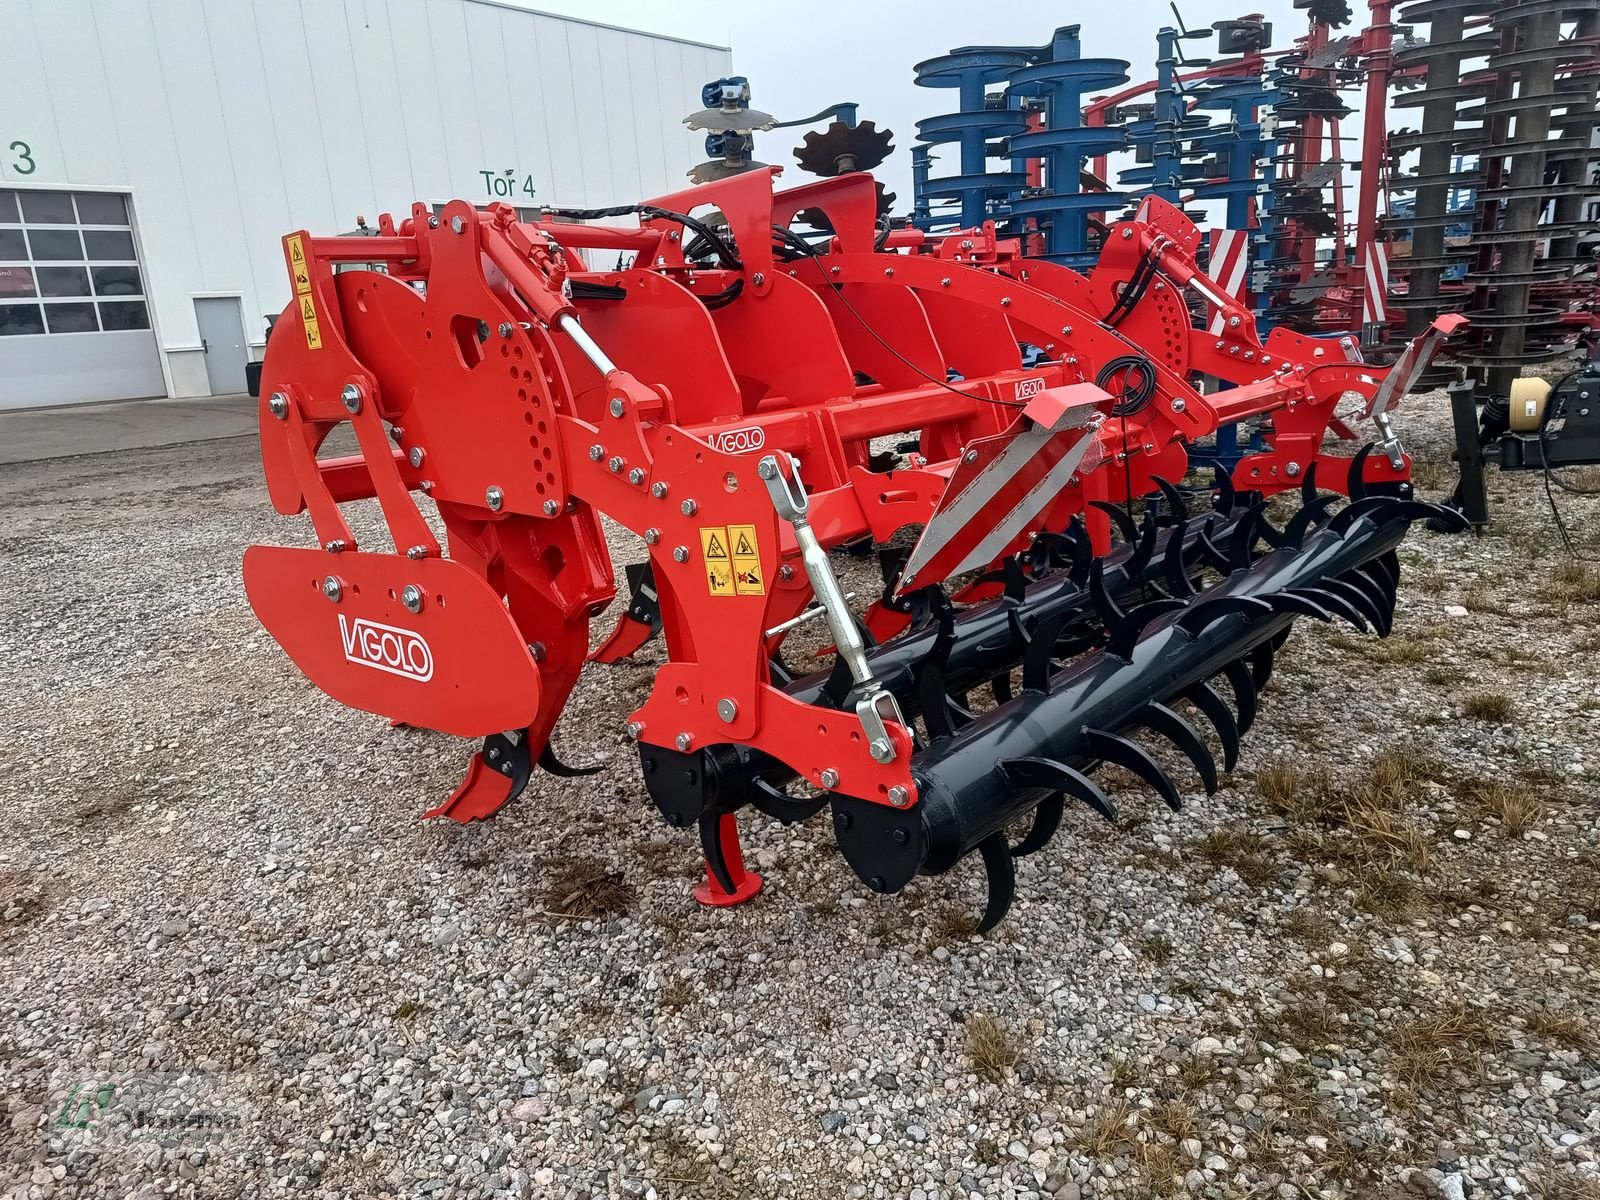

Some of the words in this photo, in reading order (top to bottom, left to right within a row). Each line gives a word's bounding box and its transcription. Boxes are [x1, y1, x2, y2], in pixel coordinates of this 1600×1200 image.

[10, 141, 36, 174] 3
[479, 171, 515, 196] Tor
[523, 175, 536, 198] 4
[1015, 378, 1045, 400] VIGOLO
[708, 426, 765, 454] VIGOLO
[338, 614, 433, 682] VIGOLO
